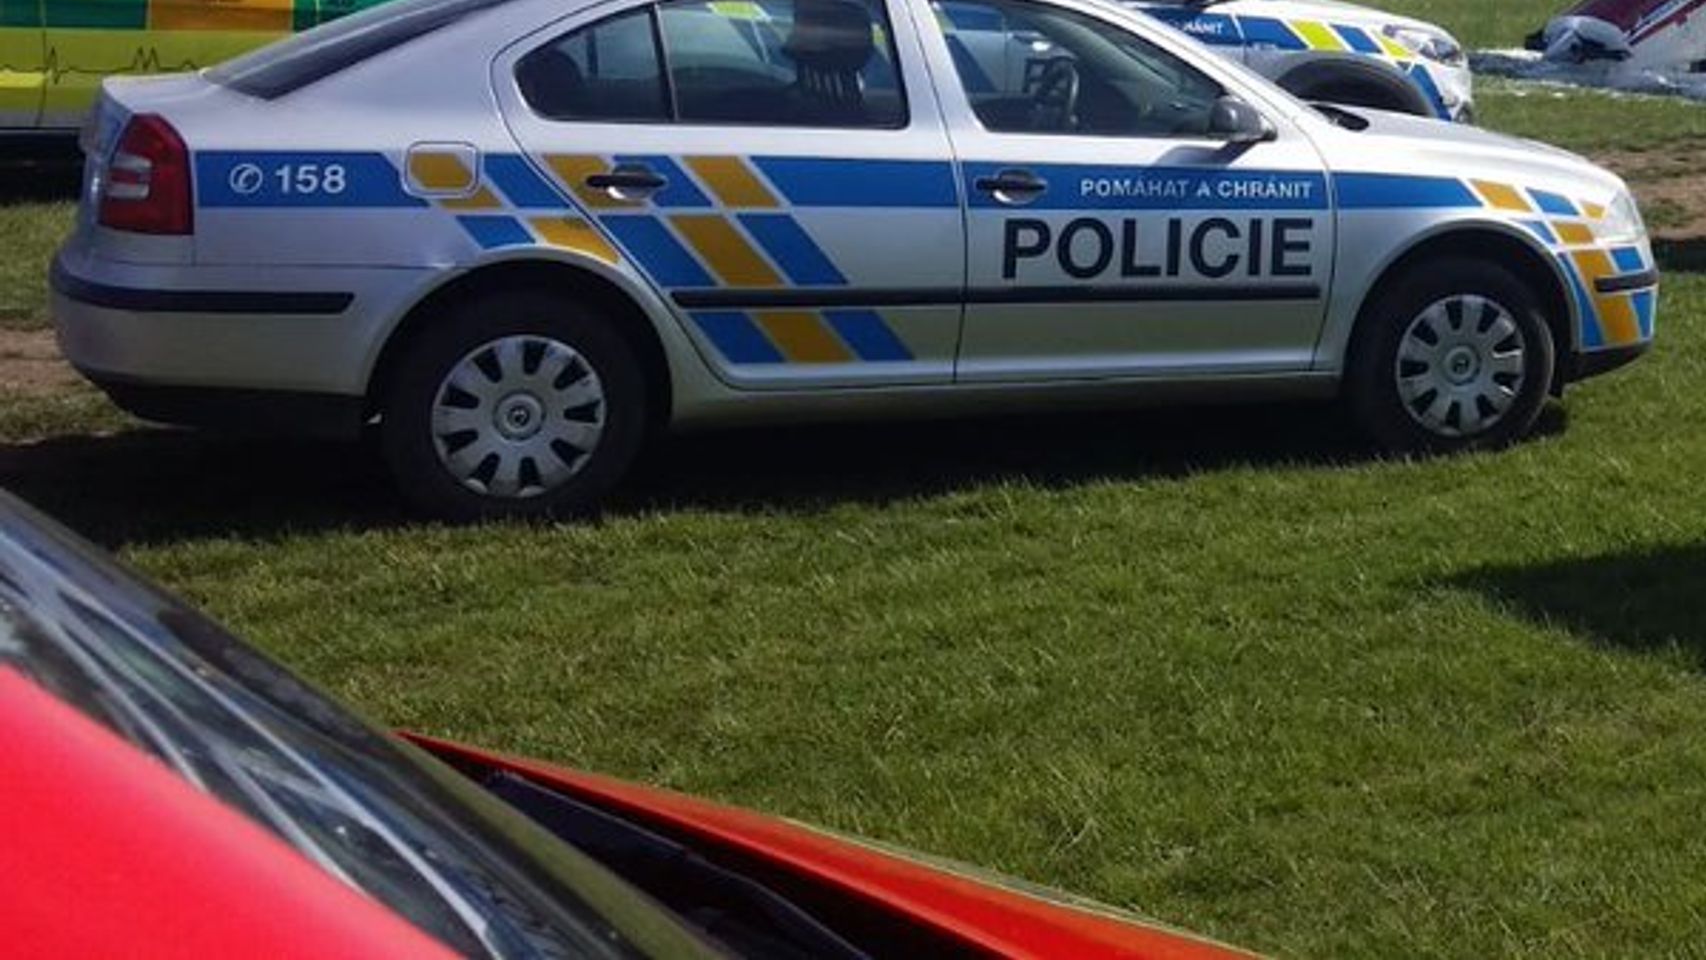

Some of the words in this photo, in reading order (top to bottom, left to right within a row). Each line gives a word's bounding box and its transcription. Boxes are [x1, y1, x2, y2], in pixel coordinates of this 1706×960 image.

[275, 164, 346, 194] 158
[1080, 175, 1189, 197] POMÁHAT
[1196, 180, 1211, 197] A
[1218, 175, 1312, 199] CHRÁNIT
[1002, 217, 1313, 280] POLICIE
